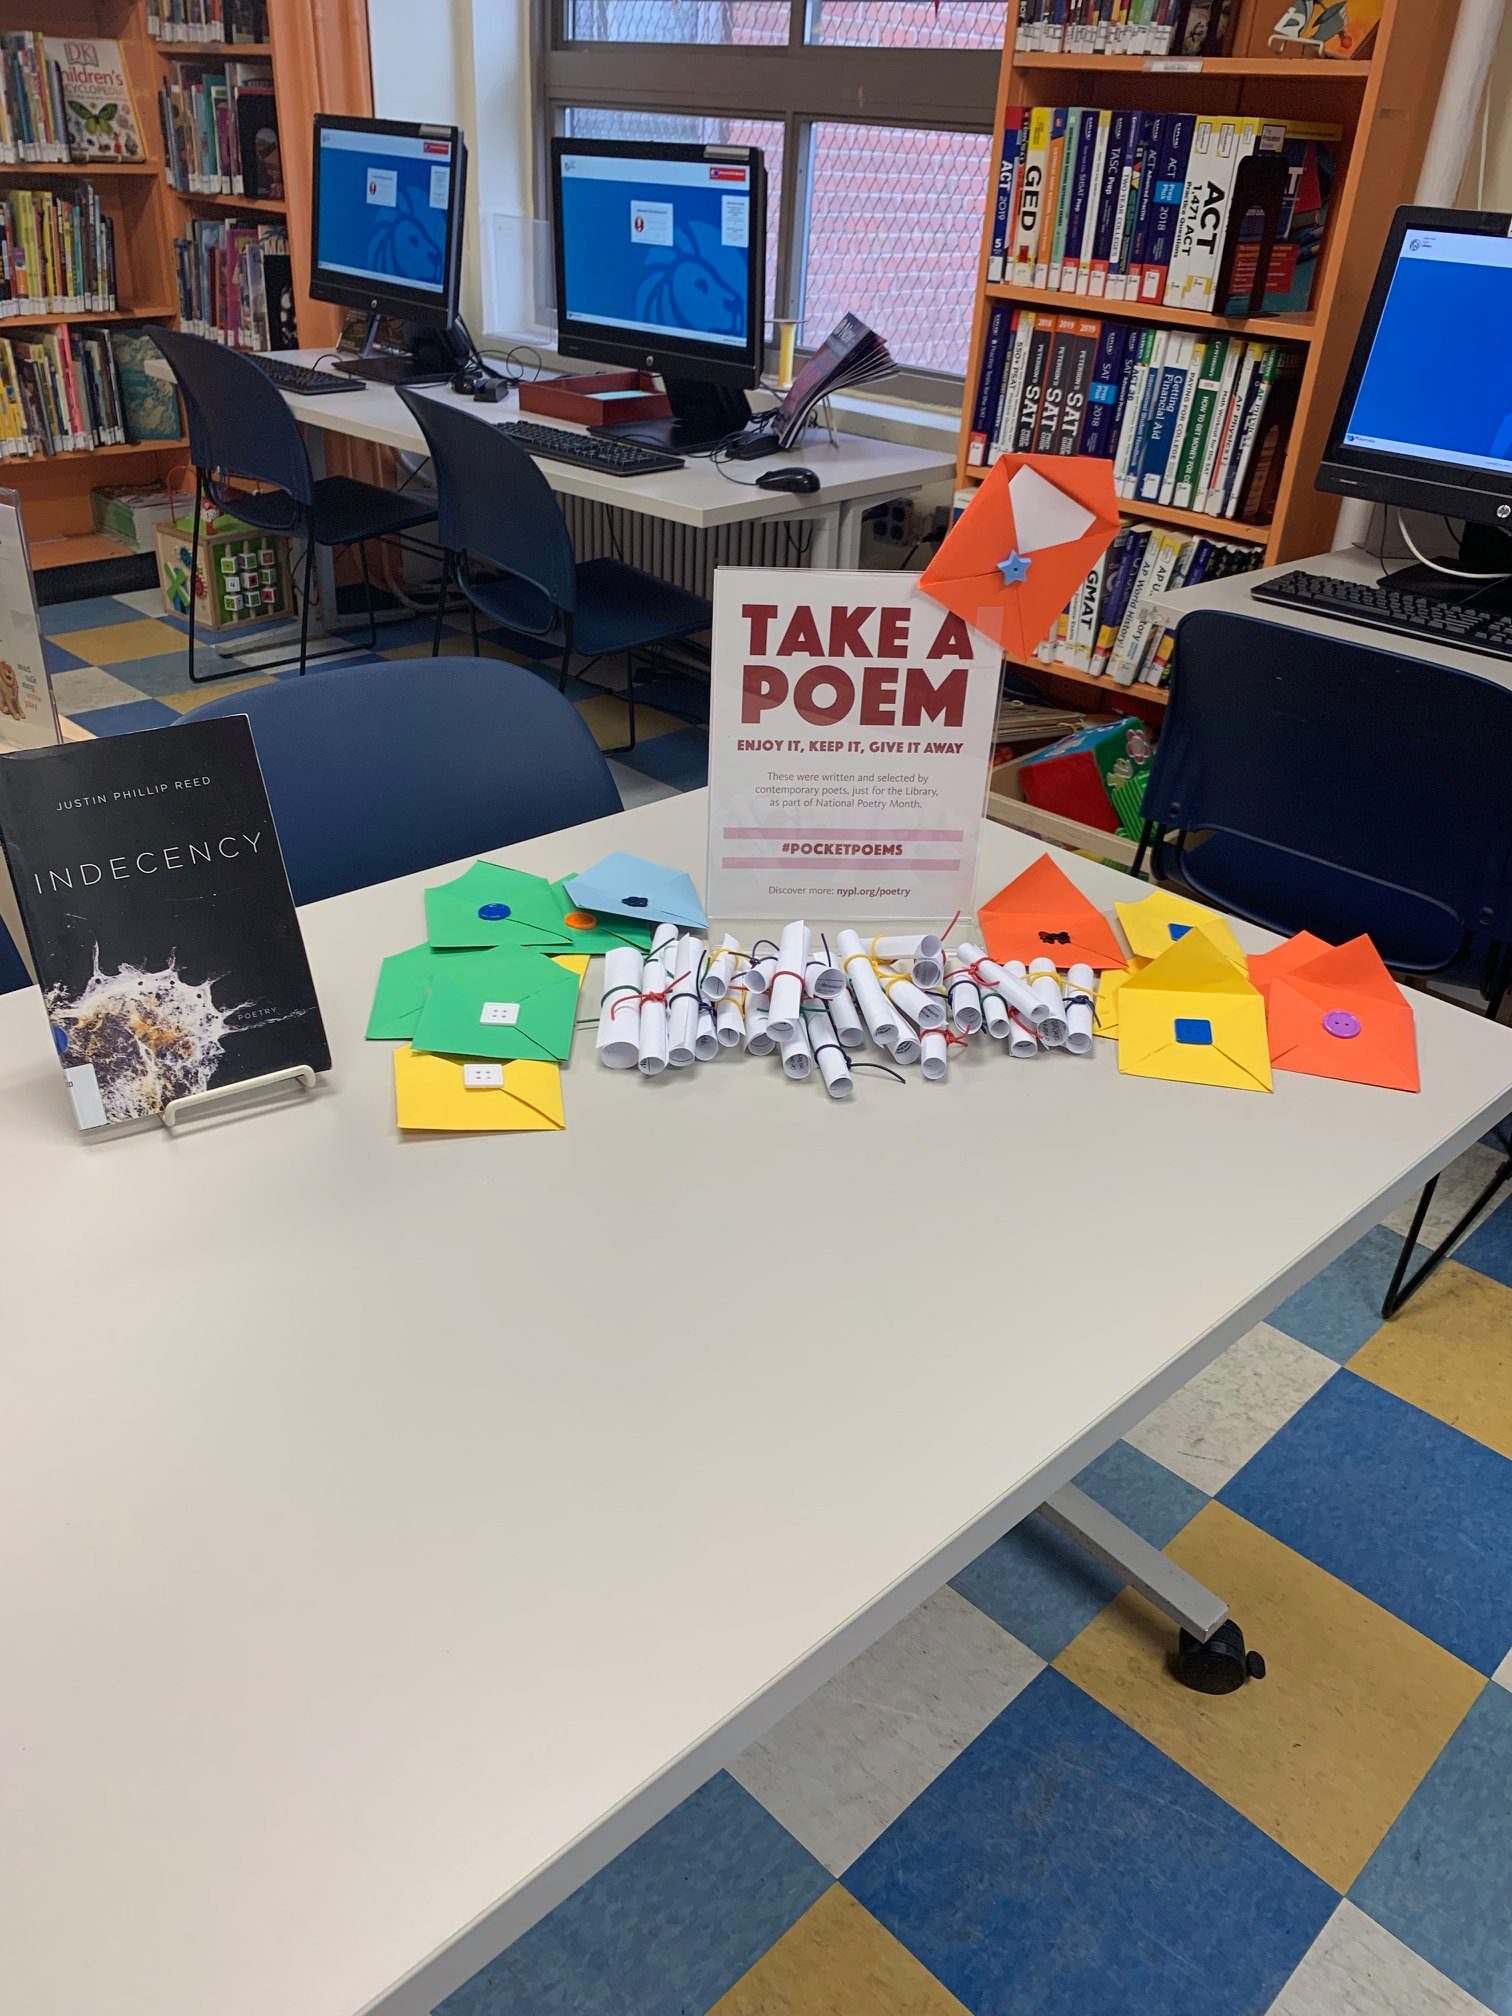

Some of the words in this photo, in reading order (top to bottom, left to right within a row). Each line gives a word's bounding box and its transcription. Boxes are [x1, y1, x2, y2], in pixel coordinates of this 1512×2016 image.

[68, 43, 94, 57] DK
[62, 67, 124, 86] hildren's
[64, 85, 124, 96] CYCLOPEDIA
[1109, 148, 1120, 174] TASC
[1148, 149, 1157, 167] ACT
[1167, 158, 1177, 177] ACT
[999, 160, 1013, 191] ACT
[1105, 177, 1115, 195] Prep
[1021, 165, 1043, 231] GED
[1161, 184, 1169, 200] Plus
[1167, 184, 1175, 201] Prep
[1181, 181, 1191, 215] Practice
[998, 196, 1008, 220] 2019
[1158, 206, 1169, 231] 2018
[1197, 180, 1225, 254] ACT
[1112, 217, 1123, 257] COLLEGES
[1174, 217, 1185, 258] Questions
[1182, 225, 1195, 256] ACT
[987, 345, 996, 370] Practice
[1014, 342, 1023, 364] 550+
[1010, 367, 1019, 389] PSAT
[1101, 363, 1111, 380] SAT
[1123, 359, 1132, 375] SAT
[1131, 369, 1139, 386] ACT
[1100, 385, 1108, 401] Prep
[1128, 389, 1135, 401] 36
[1143, 374, 1154, 411] International
[1156, 373, 1173, 420] Financial
[1167, 375, 1183, 413] Getting
[1184, 372, 1195, 403] PAYING
[1258, 389, 1264, 400] AP
[1021, 385, 1040, 428] SAT
[1041, 388, 1062, 431] SAT
[1200, 396, 1208, 413] HOW
[1220, 390, 1228, 408] Math
[1236, 395, 1243, 411] AP
[1062, 392, 1084, 436] SAT
[1092, 405, 1102, 427] 2018
[1180, 405, 1188, 422] FOR
[1198, 414, 1204, 422] TO
[1213, 409, 1224, 438] Workout
[1152, 422, 1163, 440] Aid
[1194, 423, 1202, 436] GET
[1225, 415, 1238, 453] Physics
[1131, 436, 1141, 467] Handbook
[1171, 423, 1183, 459] COLLEGE
[1189, 437, 1199, 461] MONEY
[1186, 461, 1194, 474] FOR
[1142, 561, 1150, 576] AP
[1156, 566, 1167, 582] AP
[1081, 570, 1099, 630] GMAT
[1130, 579, 1144, 609] World
[742, 604, 911, 658] TAKE
[926, 610, 974, 660] A
[1117, 608, 1134, 646] History
[741, 664, 969, 727] POEM
[737, 740, 784, 752] ENJOY
[788, 740, 805, 754] IT,
[809, 740, 844, 752] KEEP
[848, 741, 865, 754] IT,
[869, 741, 904, 753] GIVE
[907, 742, 921, 753] IT
[923, 742, 964, 754] AWAY
[768, 772, 794, 781] These
[822, 772, 855, 782] written
[857, 773, 875, 782] and
[877, 773, 915, 783] selected
[918, 773, 929, 785] by
[56, 795, 107, 811] JUSTIN
[113, 783, 169, 801] PHILLIP
[175, 776, 212, 790] REED
[755, 787, 820, 797] contemporary
[822, 787, 850, 797] poets,
[852, 786, 869, 797] just
[872, 786, 885, 795] for
[888, 786, 902, 795] the
[905, 787, 939, 797] Library,
[782, 799, 801, 808] part
[803, 798, 814, 807] of
[816, 799, 855, 808] National
[857, 800, 887, 810] Poetry
[889, 799, 922, 808] Month.
[782, 843, 903, 856] #POCKETPOEMS
[34, 832, 261, 895] INDECENCY
[768, 886, 806, 895] Discover
[809, 887, 834, 895] more:
[836, 887, 911, 898] nypl.org/poetry
[238, 1007, 277, 1020] POETRY
